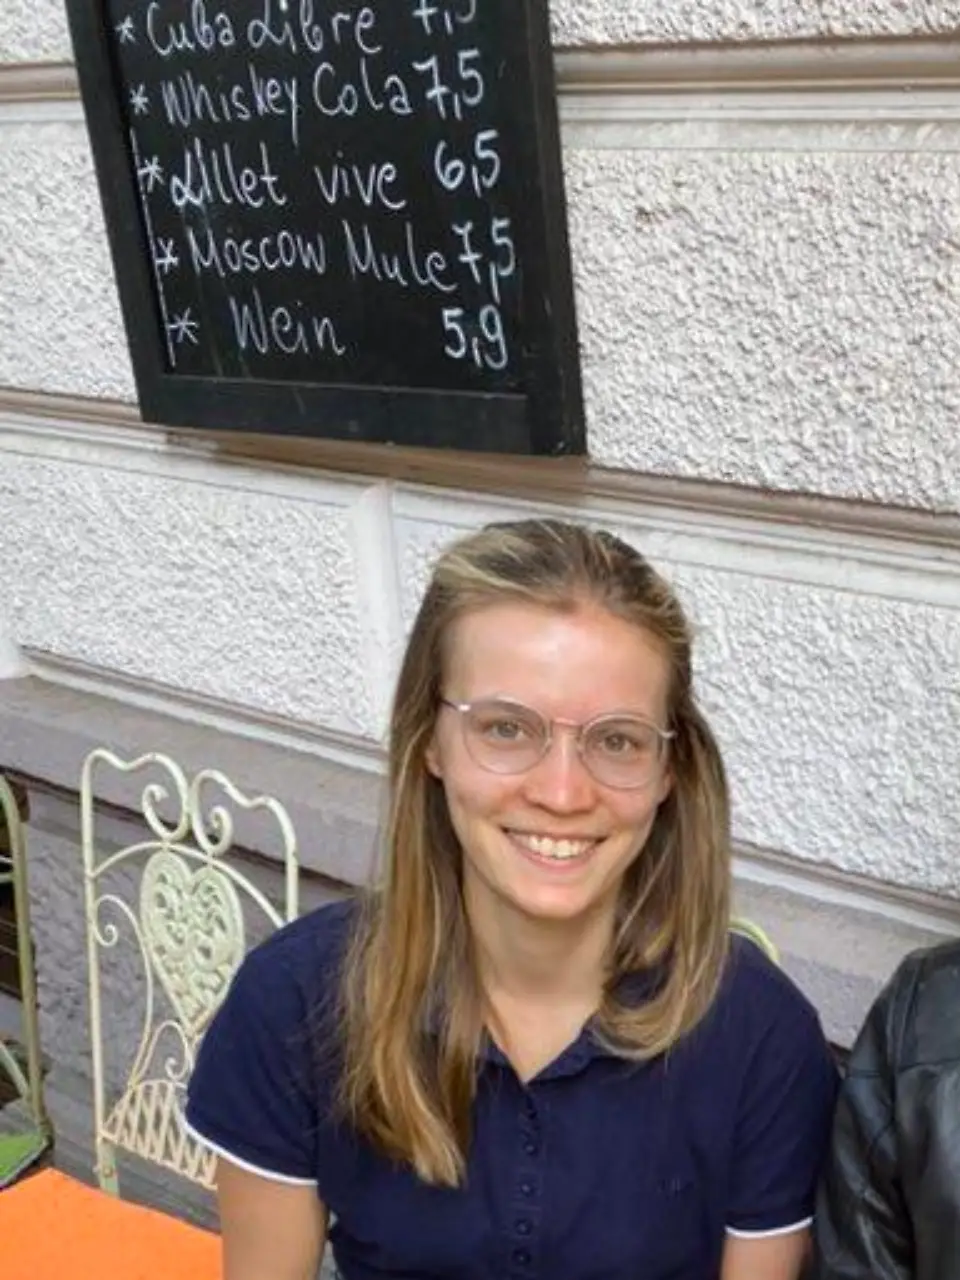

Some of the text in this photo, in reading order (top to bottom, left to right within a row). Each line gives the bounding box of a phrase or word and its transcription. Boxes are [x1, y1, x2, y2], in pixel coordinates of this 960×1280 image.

[147, 0, 236, 55] Cuba
[160, 49, 484, 145] Whiskey Cola 7,5
[314, 151, 406, 210] vive
[433, 130, 500, 197] 6,5
[186, 218, 516, 302] Moscow Mule 7,5
[228, 286, 508, 370] Wein 5,9
